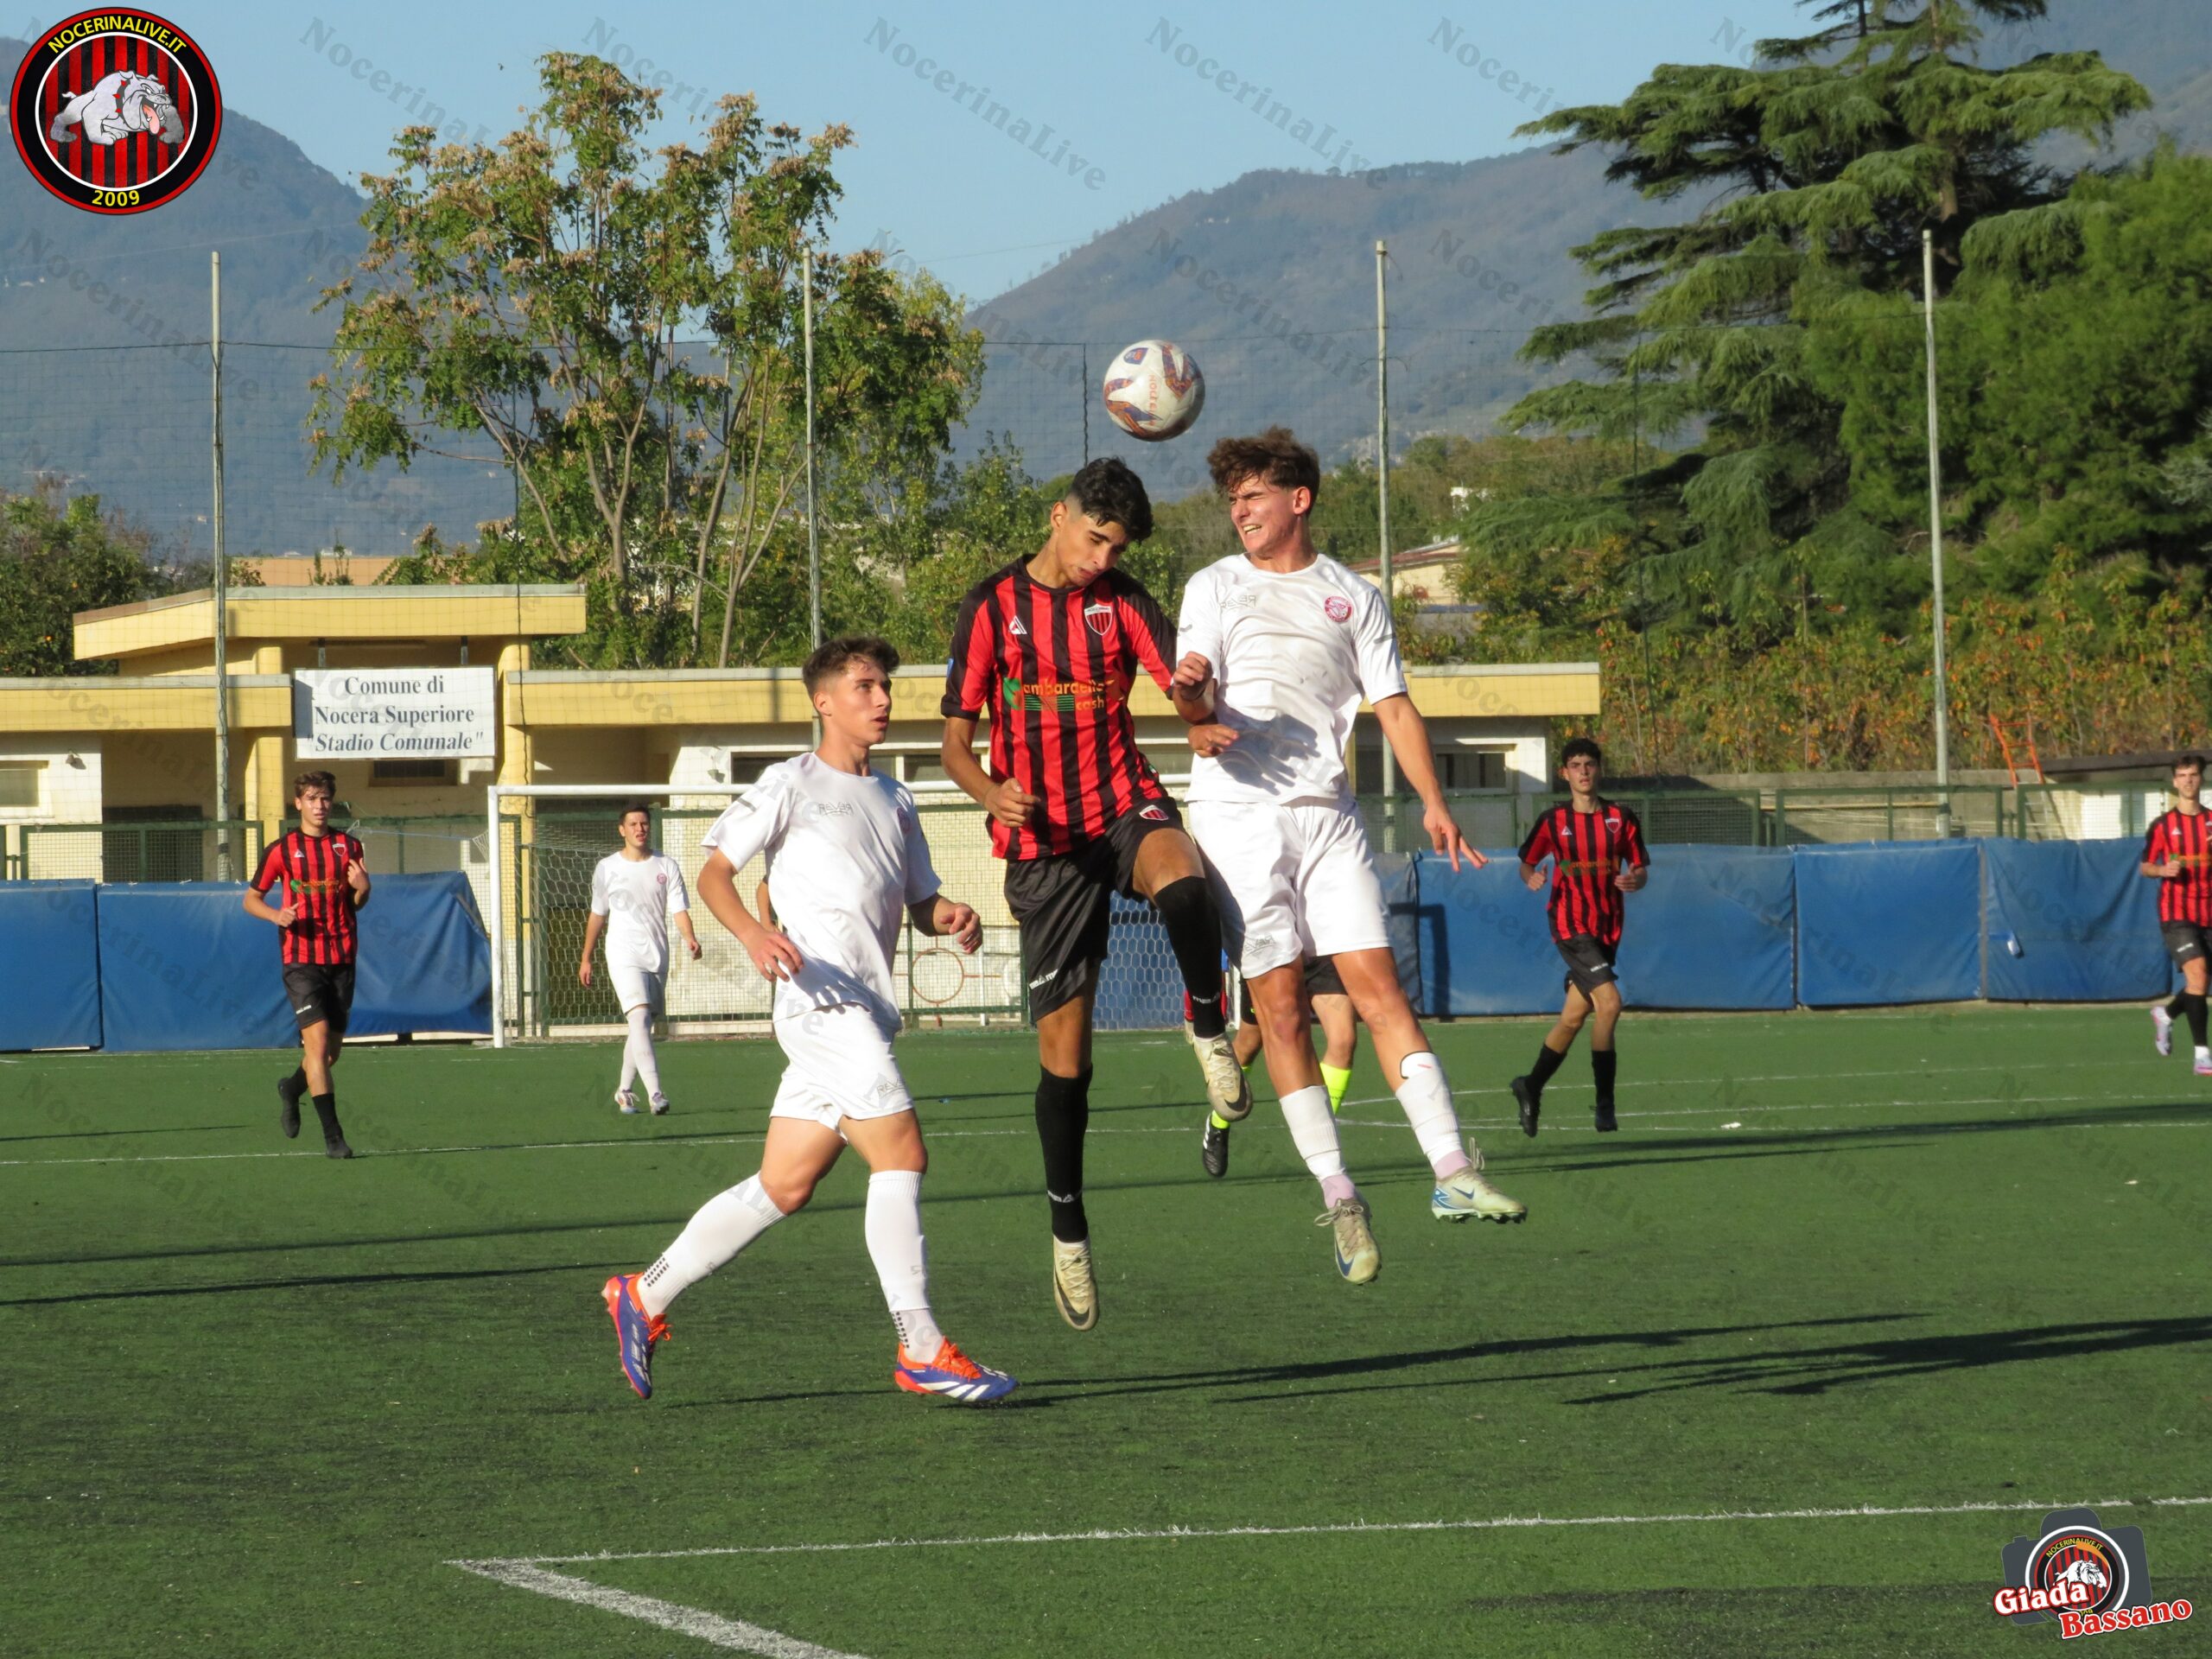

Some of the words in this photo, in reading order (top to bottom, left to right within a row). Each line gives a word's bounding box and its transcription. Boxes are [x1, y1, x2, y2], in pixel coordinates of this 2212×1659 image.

[345, 676, 422, 696] Comune
[427, 675, 445, 693] di
[1076, 695, 1104, 711] cash
[315, 706, 379, 724] Nocera
[385, 705, 475, 728] Superiore
[307, 733, 374, 753] "Stadio
[379, 732, 484, 752] Comunale"
